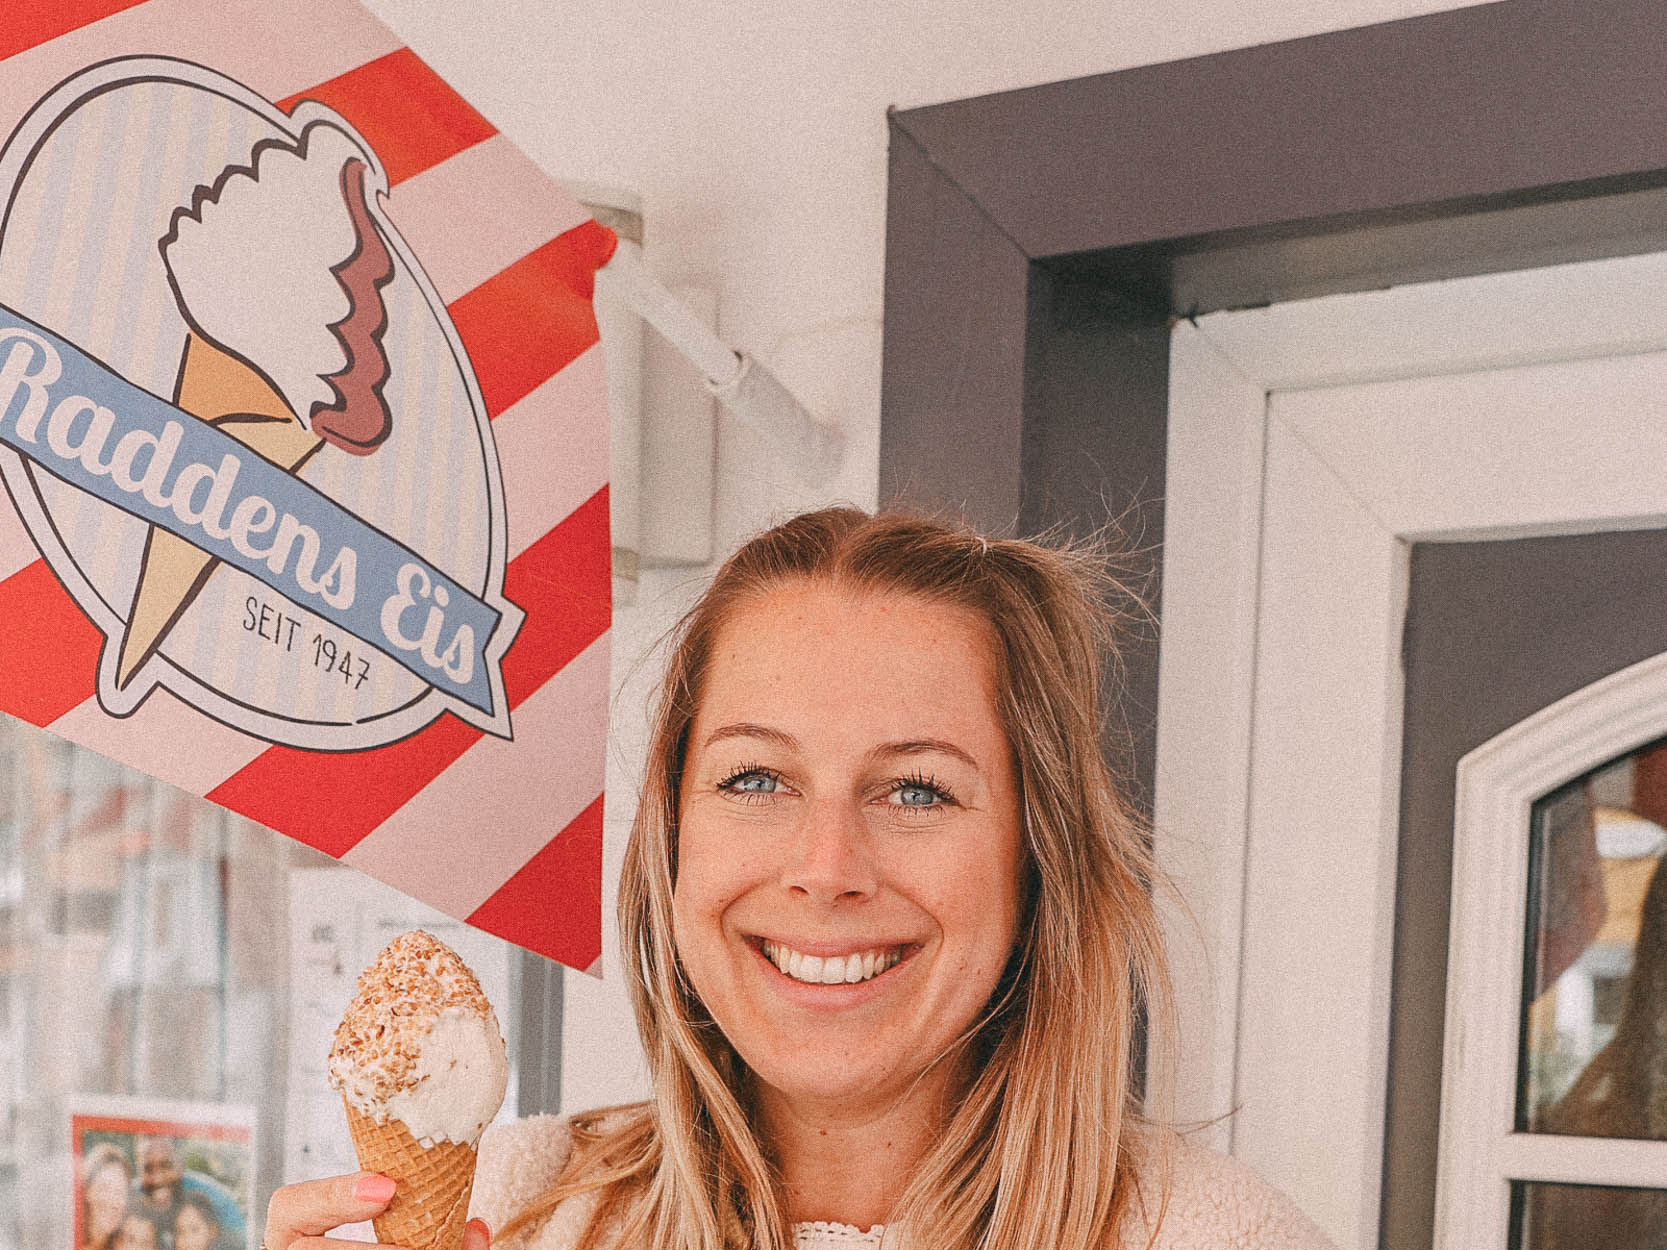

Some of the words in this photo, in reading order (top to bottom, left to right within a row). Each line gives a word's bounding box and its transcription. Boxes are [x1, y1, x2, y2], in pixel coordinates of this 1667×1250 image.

[0, 327, 358, 611] Raddens
[380, 563, 475, 684] Eis
[242, 596, 301, 653] SEIT
[312, 632, 371, 691] 1947
